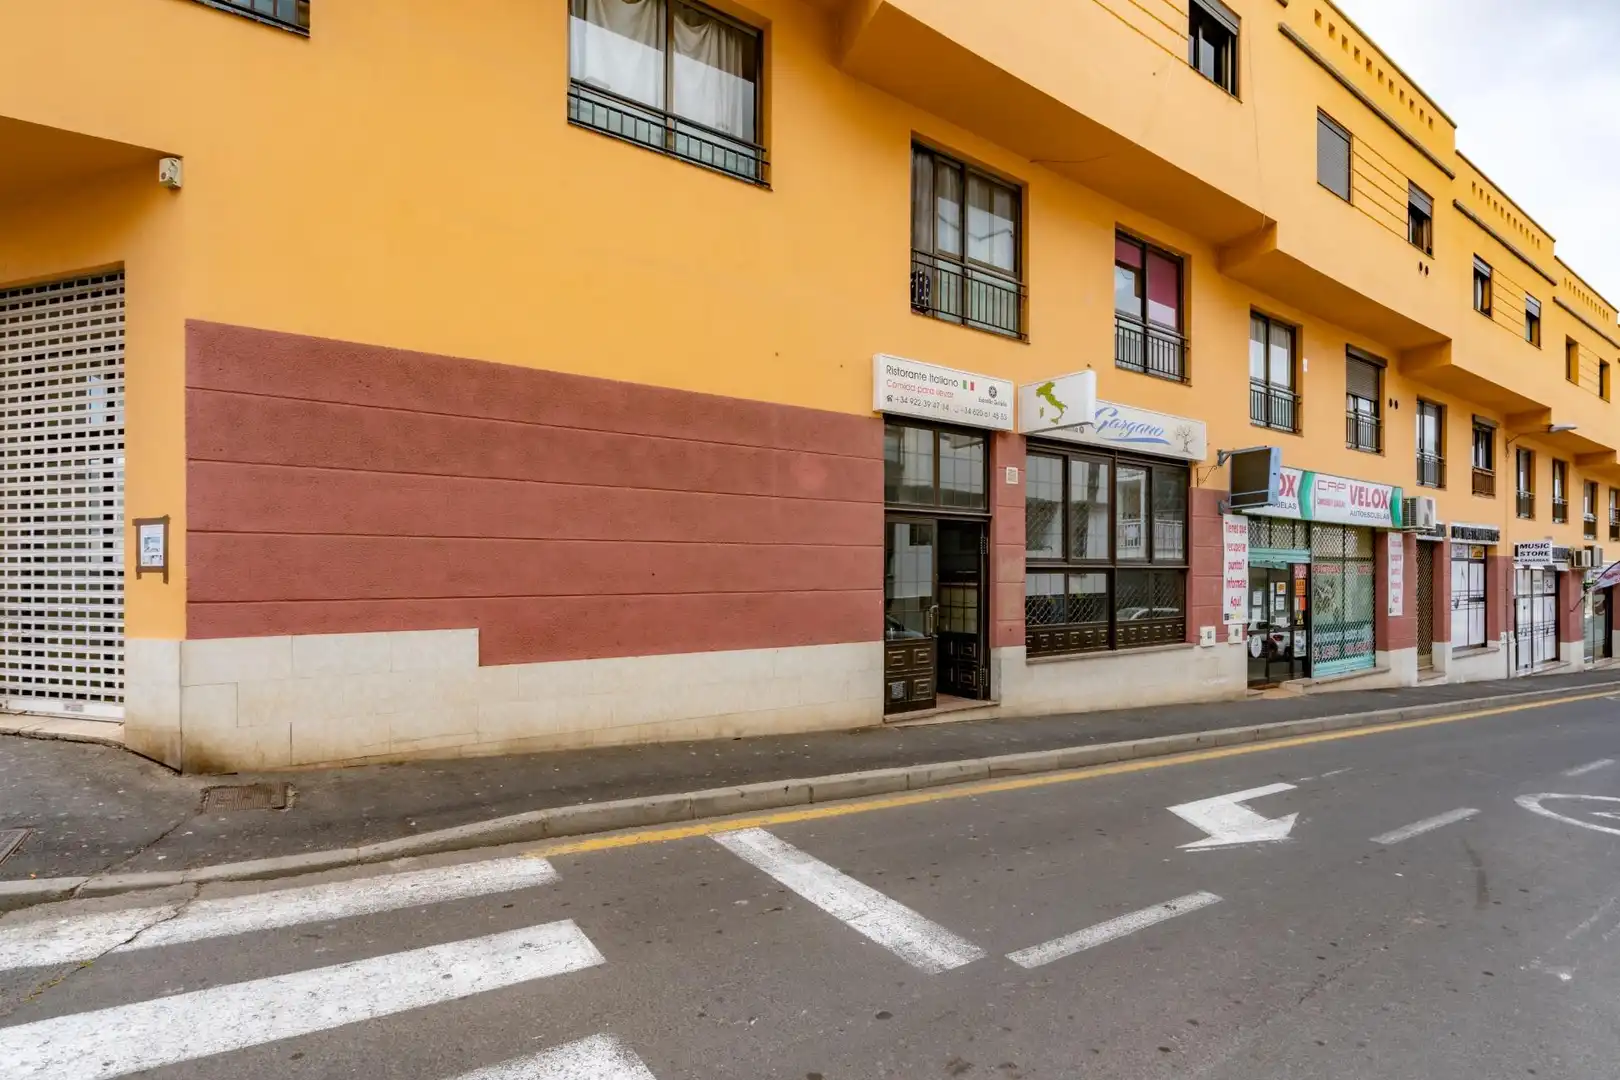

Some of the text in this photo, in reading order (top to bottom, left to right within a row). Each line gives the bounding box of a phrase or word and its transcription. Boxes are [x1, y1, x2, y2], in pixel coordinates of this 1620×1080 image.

[886, 365, 959, 388] Ristorante Italiano
[917, 384, 936, 397] para
[895, 395, 909, 405] +34
[909, 397, 922, 408] 922
[1094, 407, 1164, 437] Gargano
[1317, 479, 1347, 493] CAP
[1349, 483, 1389, 510] VELOX
[1349, 510, 1390, 520] AUTOESCUELAS
[1519, 542, 1550, 550] MUSIC
